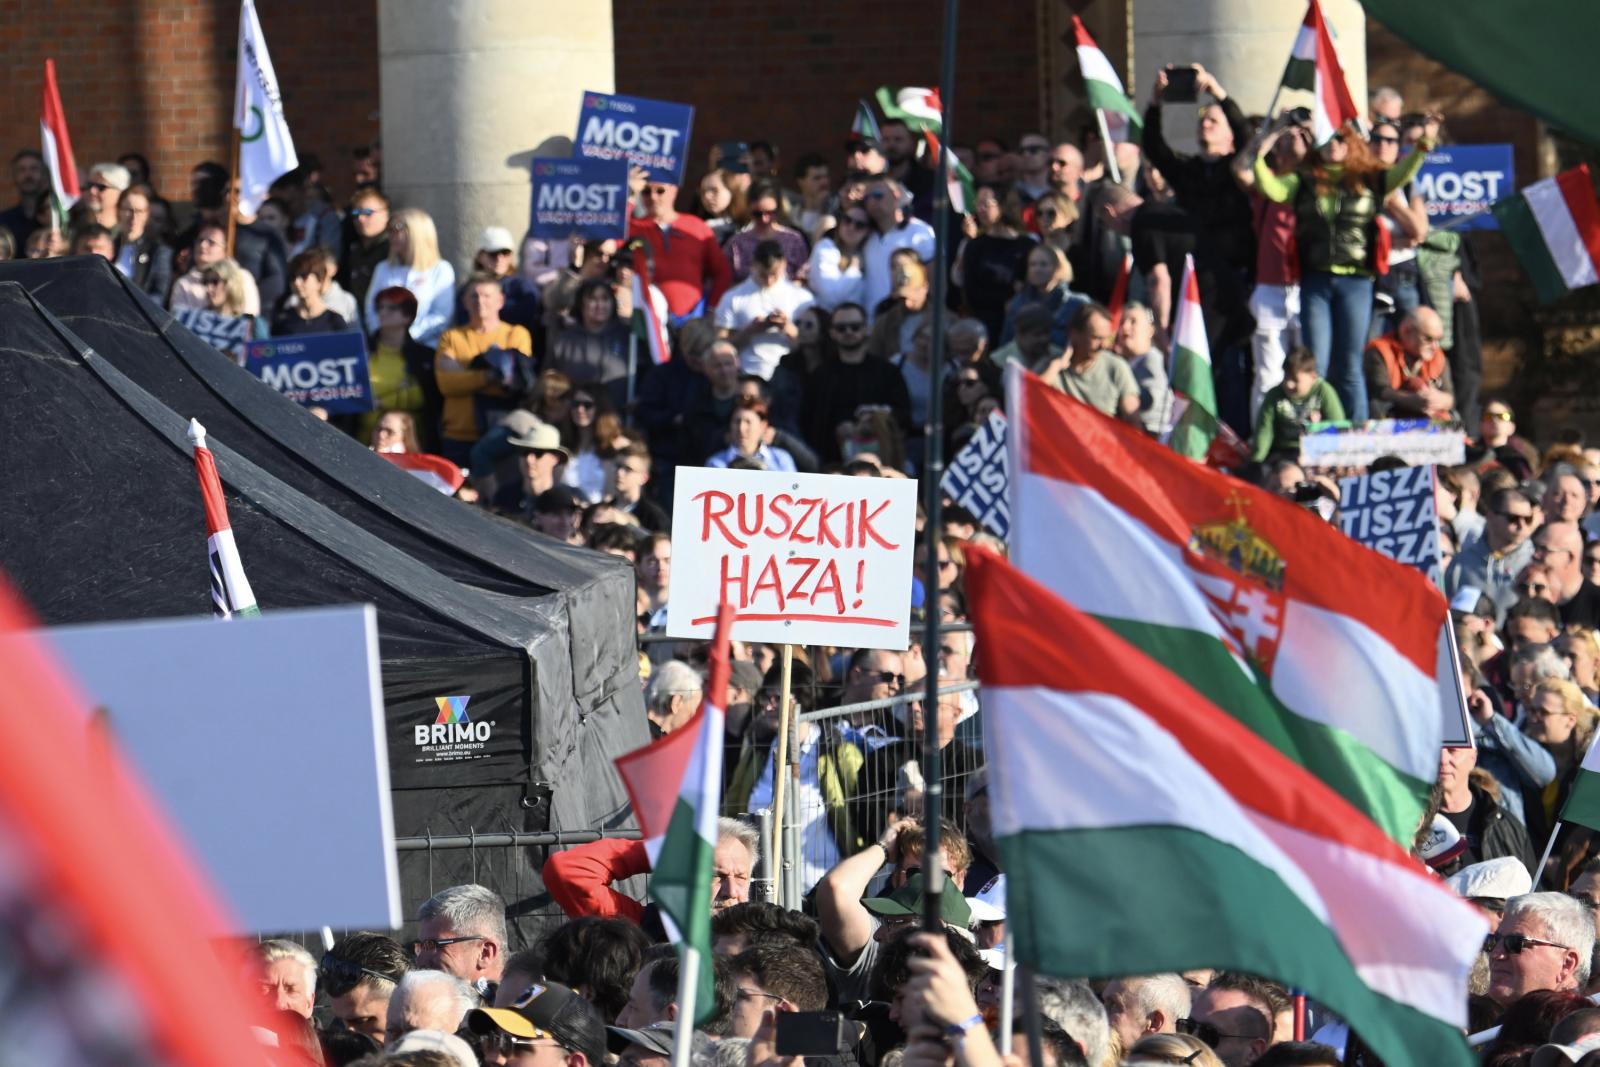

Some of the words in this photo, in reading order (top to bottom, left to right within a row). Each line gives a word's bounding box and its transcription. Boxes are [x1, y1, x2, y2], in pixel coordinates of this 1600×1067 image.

[583, 115, 680, 156] MOST
[538, 183, 622, 212] MOST
[1413, 170, 1504, 203] MOST
[173, 305, 250, 339] TISZA
[261, 357, 359, 391] MOST
[939, 408, 1008, 500] TISZA
[959, 445, 1010, 519] TISZ
[1339, 464, 1433, 507] TISZA
[691, 490, 900, 550] RUSZKIK
[1340, 495, 1437, 539] TISZA
[719, 554, 866, 615] HAZA!
[422, 744, 453, 752] BRILLIANT
